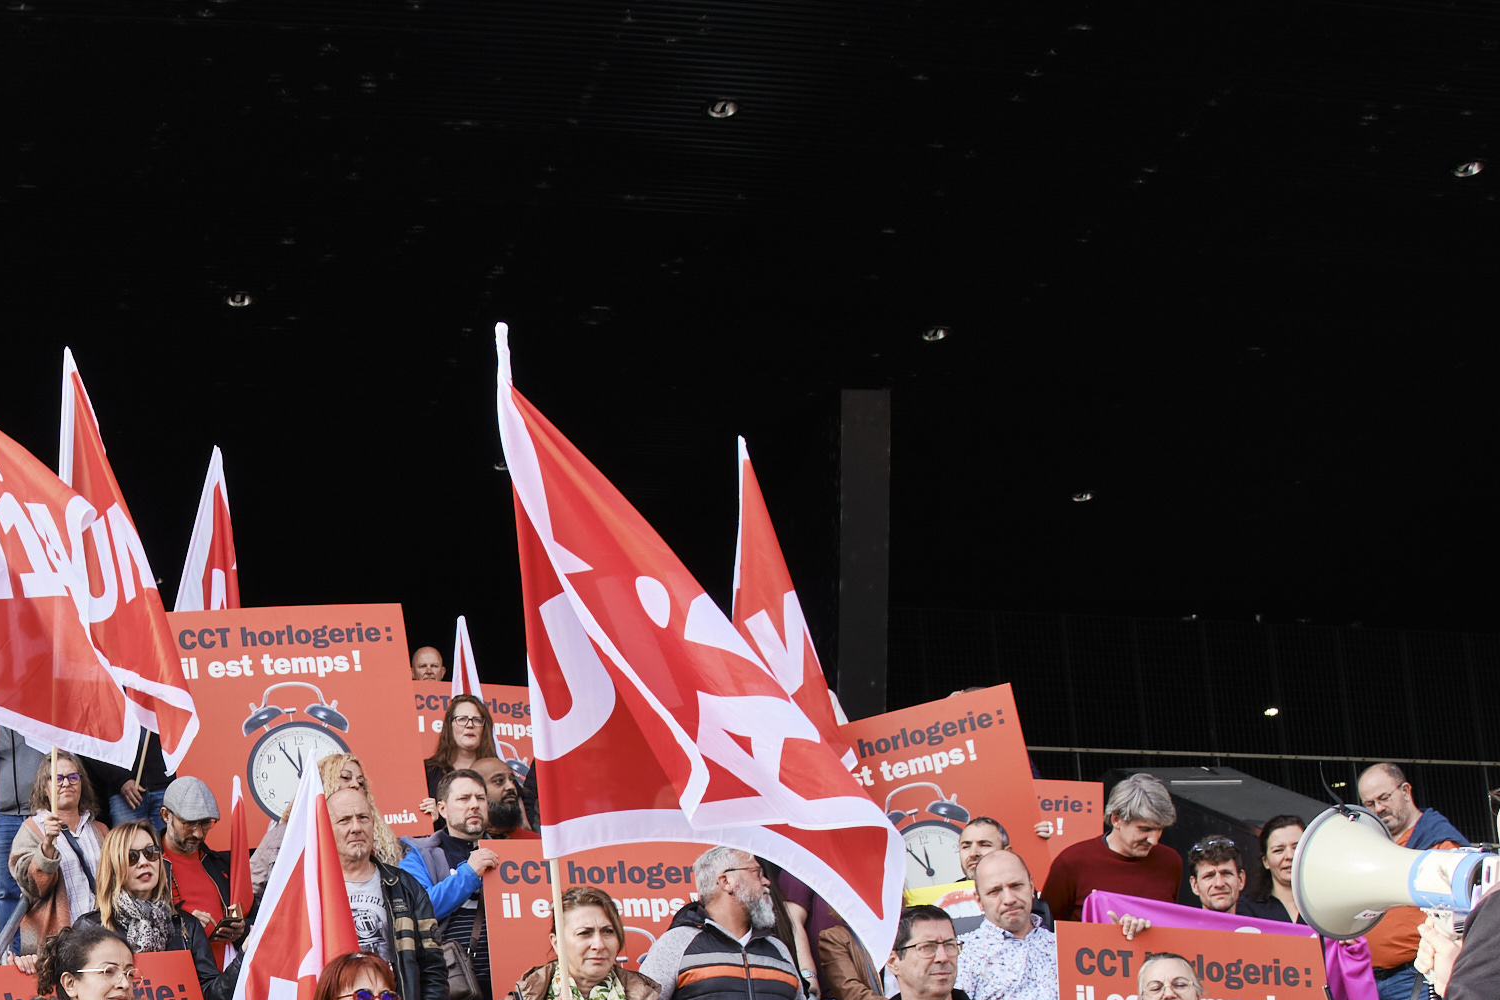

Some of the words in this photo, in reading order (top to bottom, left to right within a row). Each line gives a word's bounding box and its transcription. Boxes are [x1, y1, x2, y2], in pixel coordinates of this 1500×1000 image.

[178, 627, 231, 650] CCT
[241, 622, 393, 648] horlogerie:
[181, 657, 199, 679] il
[208, 655, 254, 678] est
[261, 650, 362, 677] temps!
[858, 710, 1005, 758] horlogerie:
[880, 739, 978, 782] temps!
[567, 860, 695, 889] horloger
[501, 893, 522, 918] il
[1075, 947, 1133, 978] CCT
